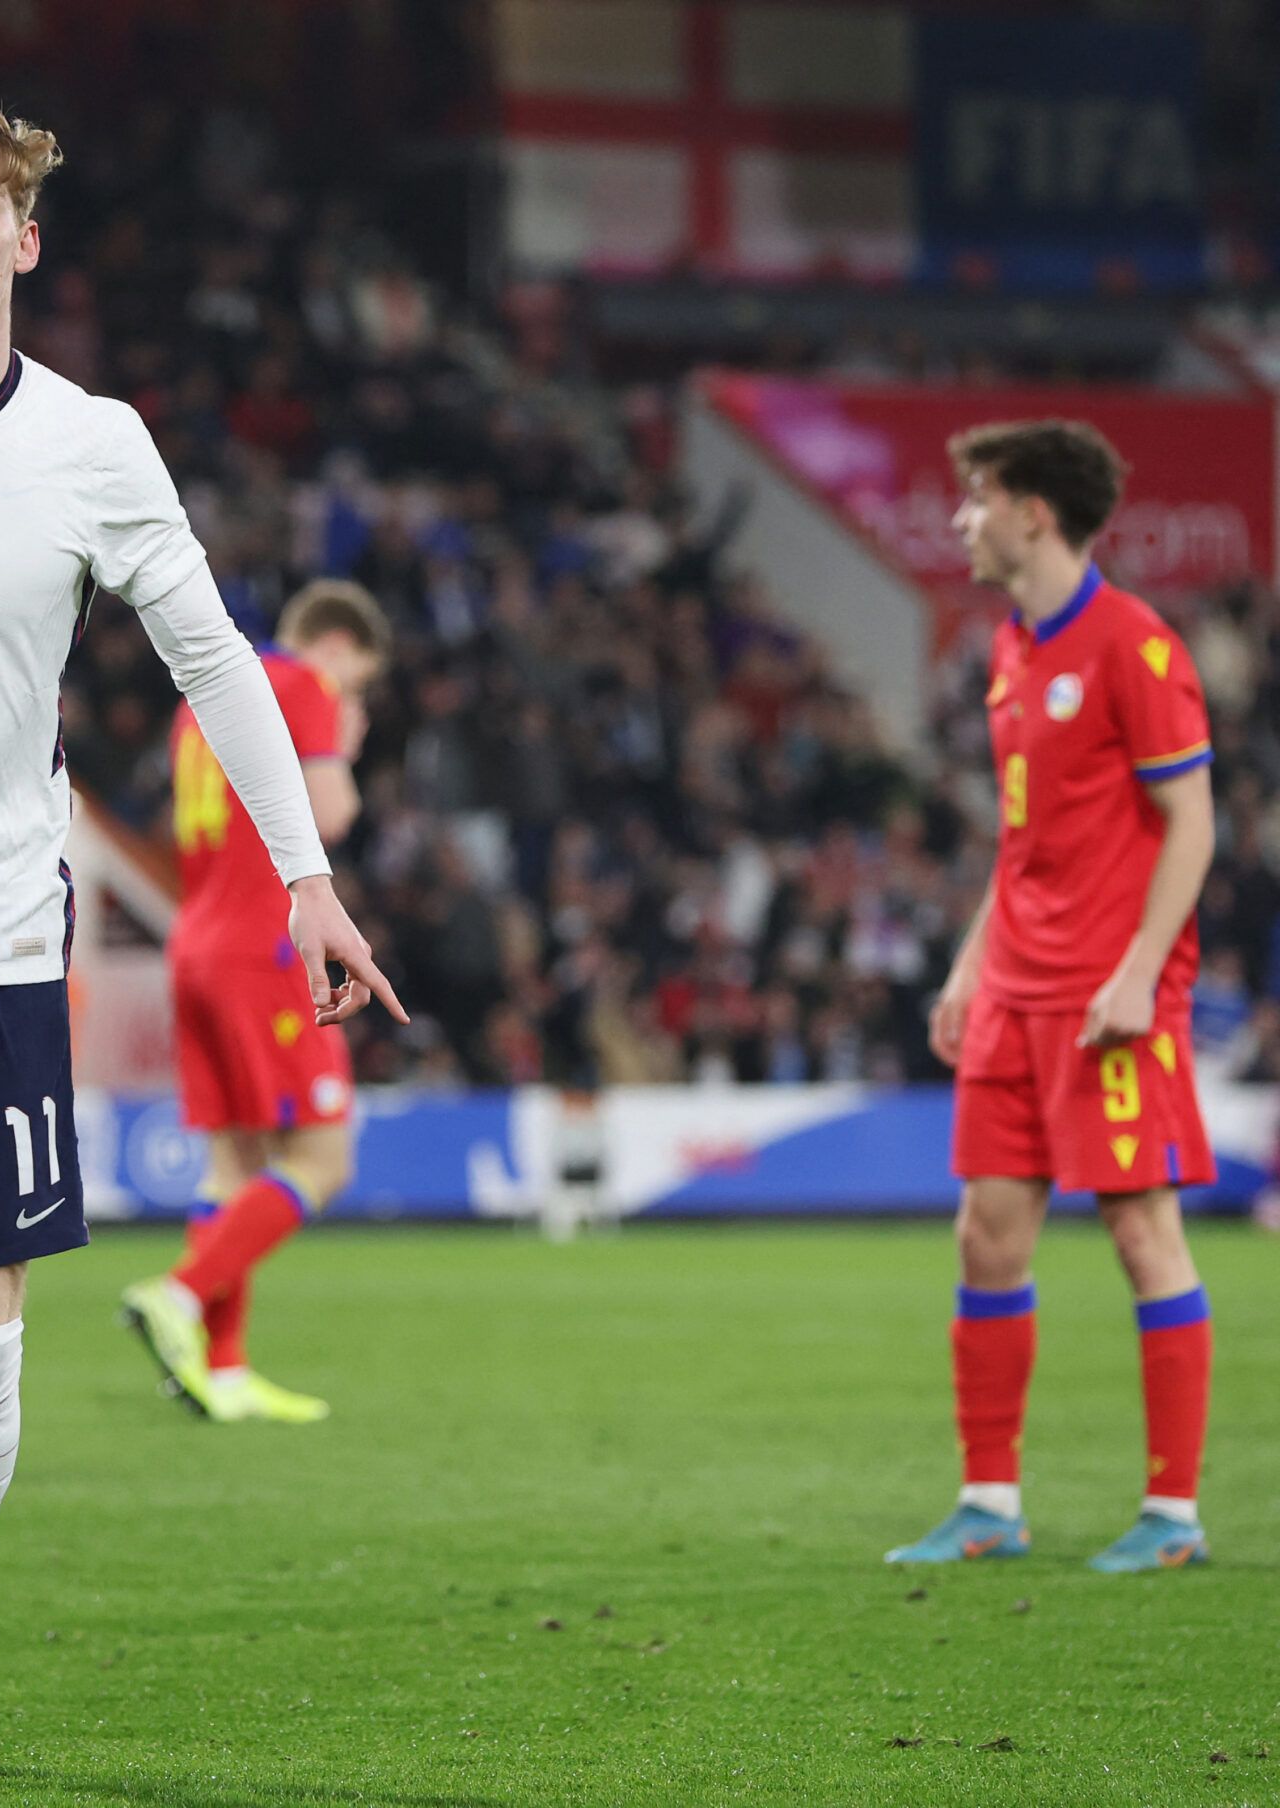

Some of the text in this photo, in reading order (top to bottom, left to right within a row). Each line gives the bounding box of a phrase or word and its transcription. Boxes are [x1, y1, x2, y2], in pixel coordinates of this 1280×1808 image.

[946, 97, 1194, 204] FIFA
[1003, 752, 1028, 829] 9
[1100, 1047, 1141, 1123] 9
[4, 1095, 61, 1196] 11
